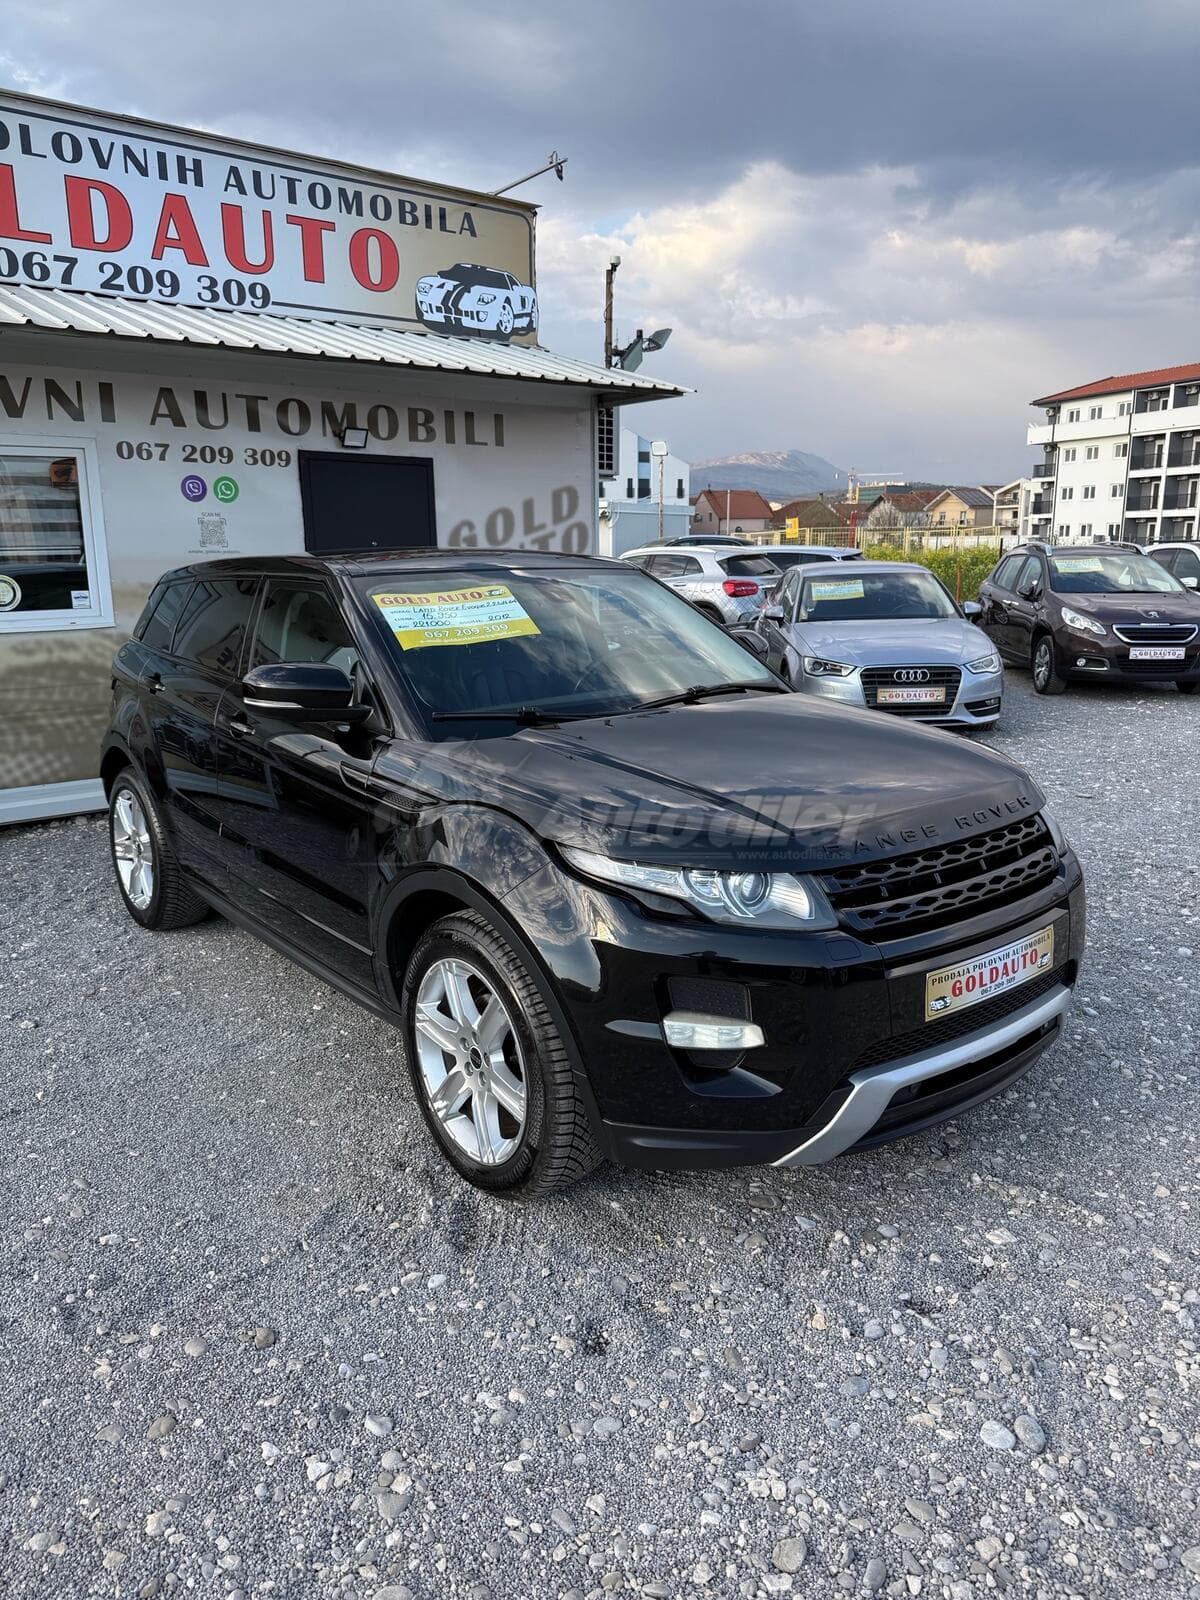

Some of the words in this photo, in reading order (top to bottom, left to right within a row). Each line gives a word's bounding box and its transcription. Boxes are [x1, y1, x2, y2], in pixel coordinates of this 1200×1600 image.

[223, 165, 478, 238] AUTOMOBILA
[0, 247, 78, 285] 067
[98, 261, 181, 297] 209
[197, 275, 272, 308] 309
[150, 386, 505, 447] AUTOMOBILI
[116, 440, 170, 461] 067
[182, 444, 234, 464] 209
[244, 448, 292, 467] 309
[447, 484, 580, 548] GOLD
[380, 596, 431, 605] GOLD
[437, 590, 483, 603] AUTO
[487, 613, 511, 621] 2012
[412, 620, 451, 628] 221000
[455, 628, 480, 637] 209
[482, 623, 509, 633] 309
[821, 824, 939, 858] RANGE
[954, 796, 1032, 830] ROVER
[931, 967, 971, 987] PRODAJA
[972, 951, 1010, 972] POLOVNIH
[1012, 933, 1050, 957] AUTOMOBILA
[951, 947, 1038, 998] GOLDAUTO
[980, 986, 992, 996] 067
